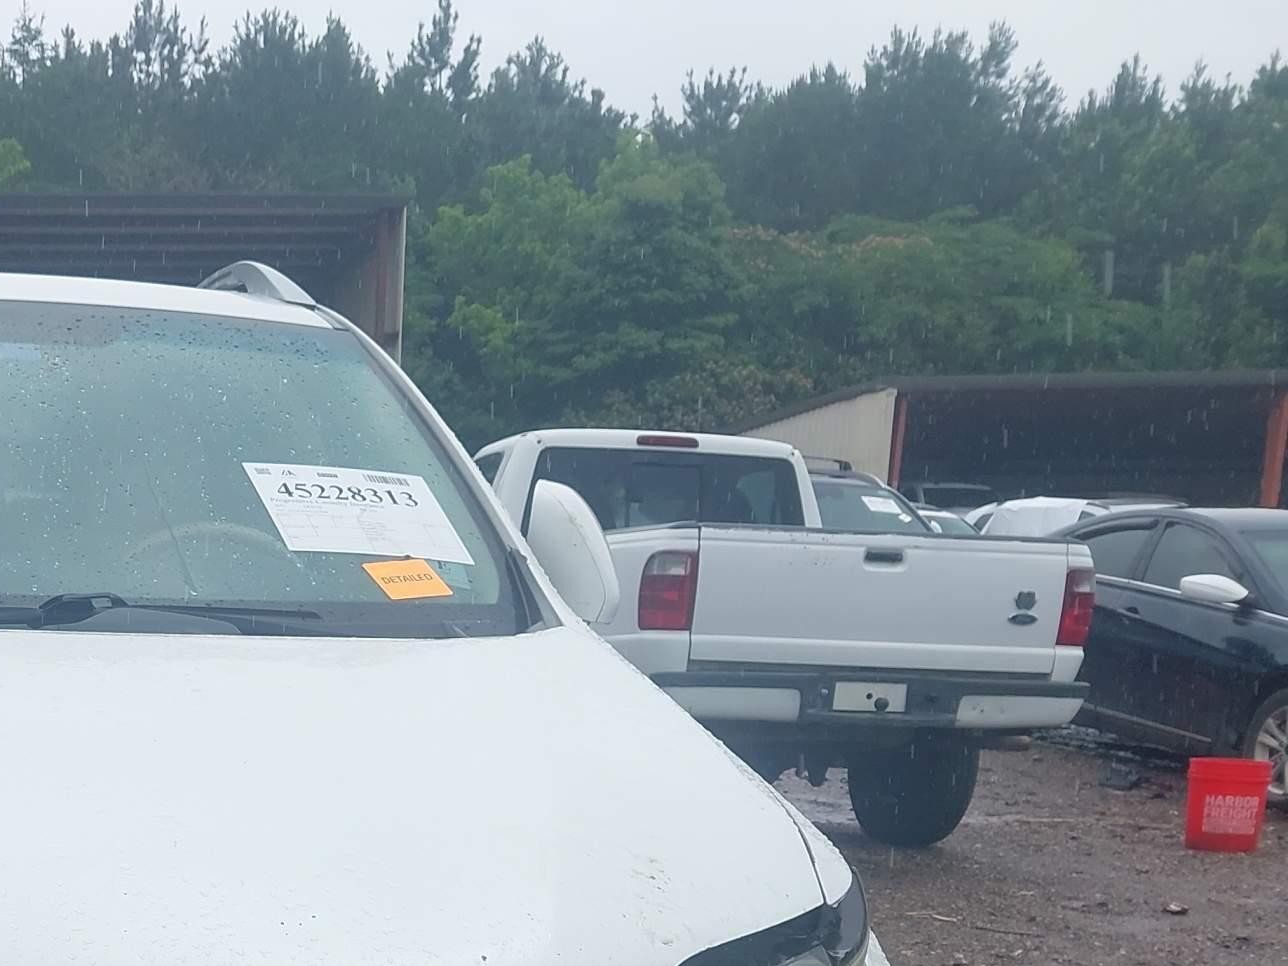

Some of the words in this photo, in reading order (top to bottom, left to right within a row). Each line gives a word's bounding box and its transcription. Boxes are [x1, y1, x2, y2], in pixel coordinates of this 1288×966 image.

[277, 482, 419, 508] 45228313
[380, 573, 433, 584] DETAILED
[1205, 795, 1260, 808] HARBOR
